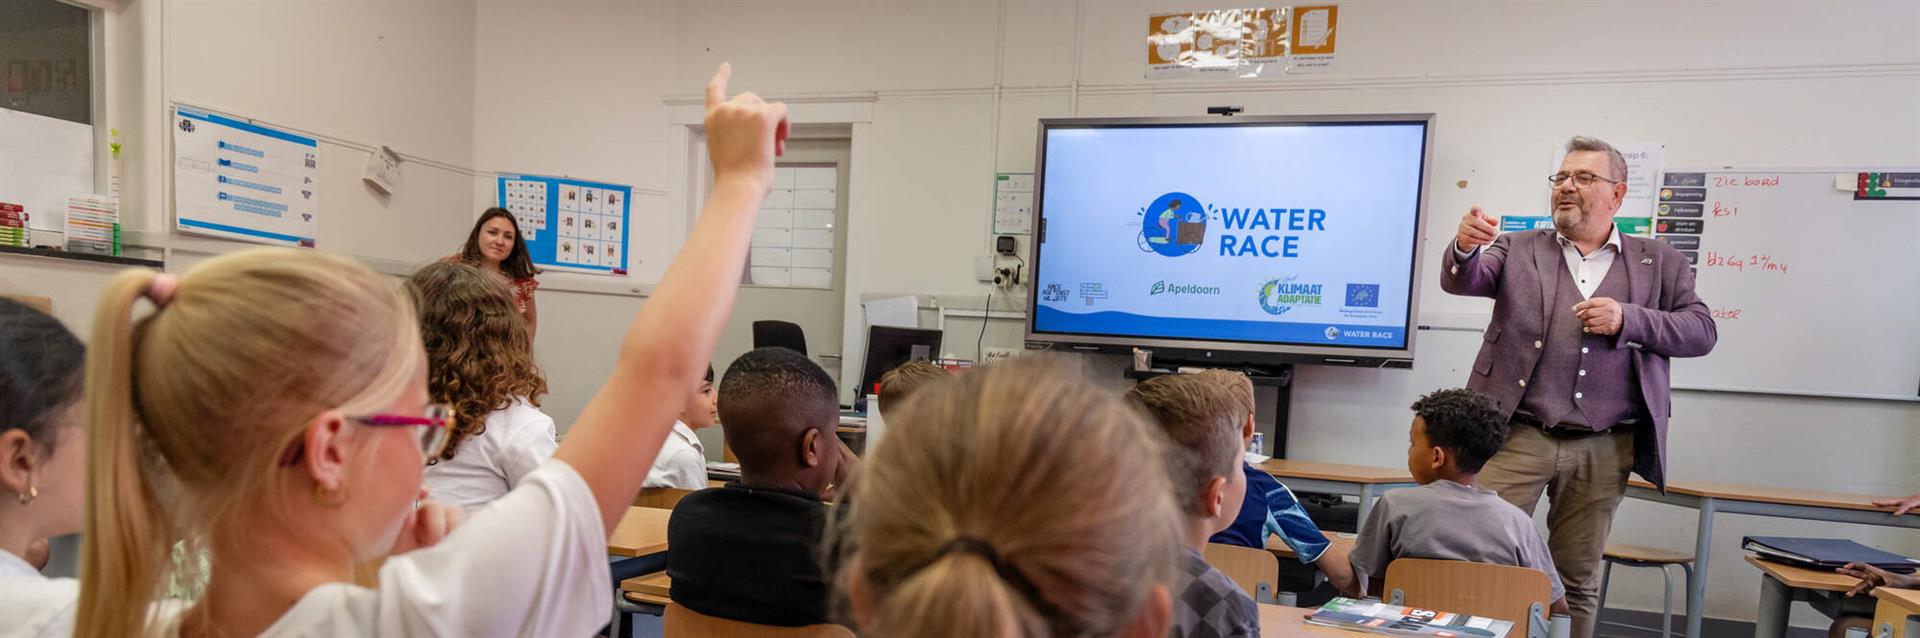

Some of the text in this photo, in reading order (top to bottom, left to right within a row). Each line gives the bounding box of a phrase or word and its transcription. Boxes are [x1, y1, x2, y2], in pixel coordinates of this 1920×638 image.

[1221, 207, 1327, 231] WATER
[1219, 235, 1300, 258] RACE
[1168, 283, 1220, 295] Apeldoorn
[1278, 283, 1323, 295] KLIMAAT
[1277, 294, 1322, 305] ADAPTATIE
[1344, 330, 1393, 339] WATER RACE
